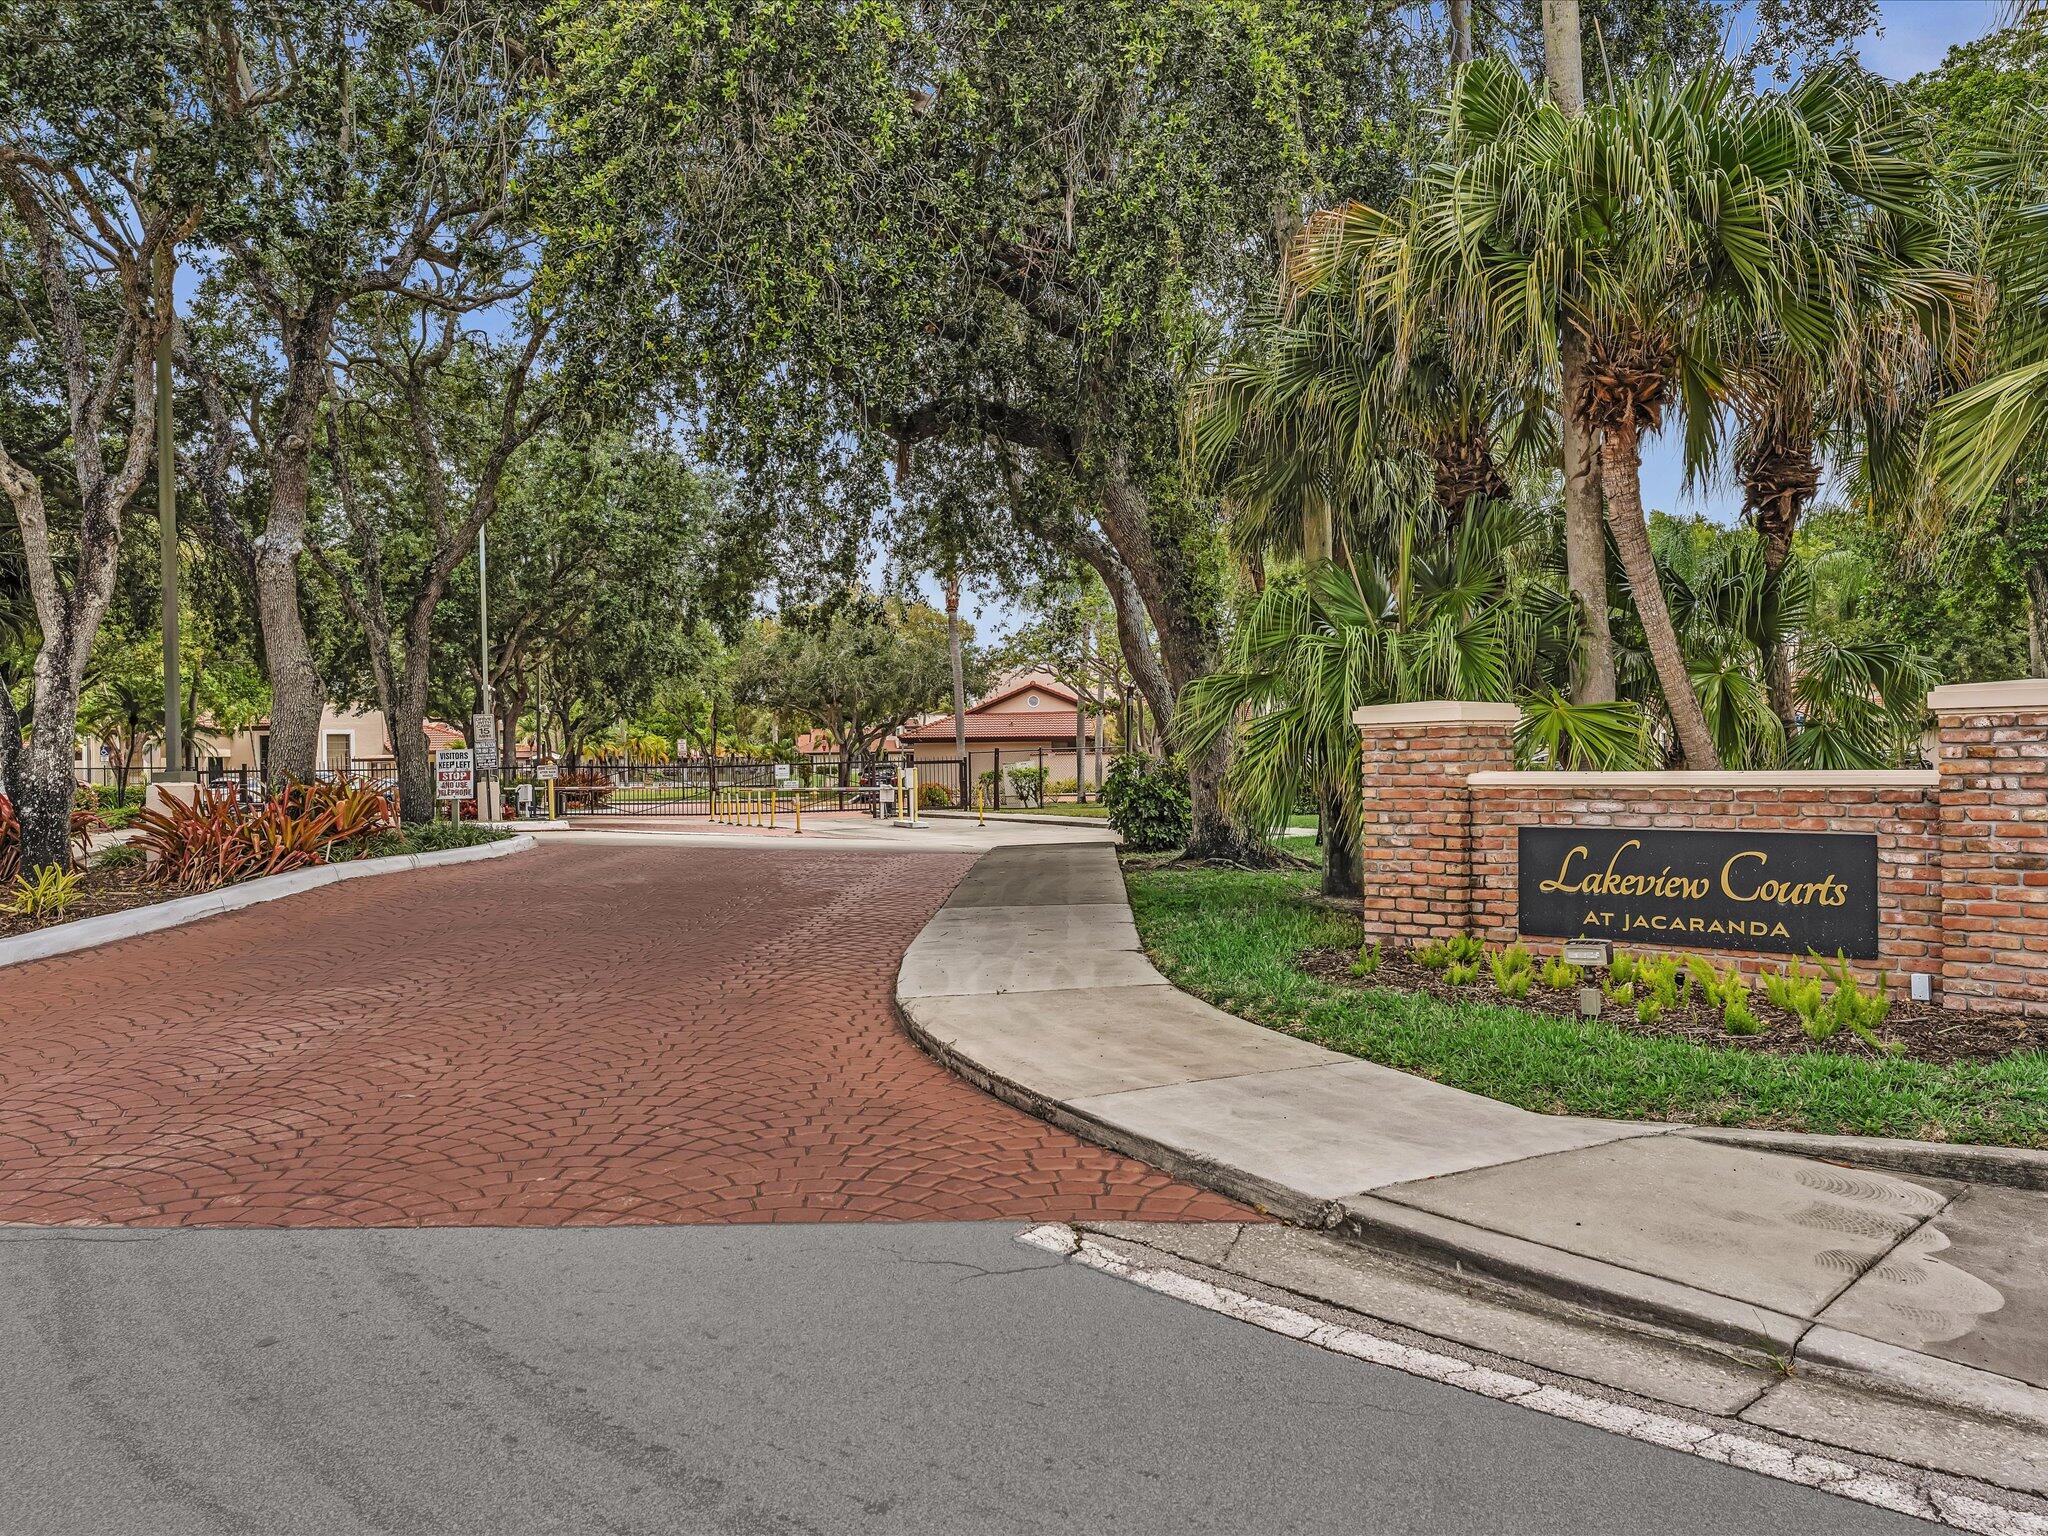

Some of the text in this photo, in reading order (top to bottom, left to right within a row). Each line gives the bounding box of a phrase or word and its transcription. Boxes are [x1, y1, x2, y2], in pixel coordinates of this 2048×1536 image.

[440, 752, 469, 760] VISITORS
[442, 772, 467, 780] STOP
[438, 789, 471, 797] TELEPHONE
[1539, 839, 1848, 906] Lakeview Courts
[1582, 910, 1791, 938] AT JACARANDA
